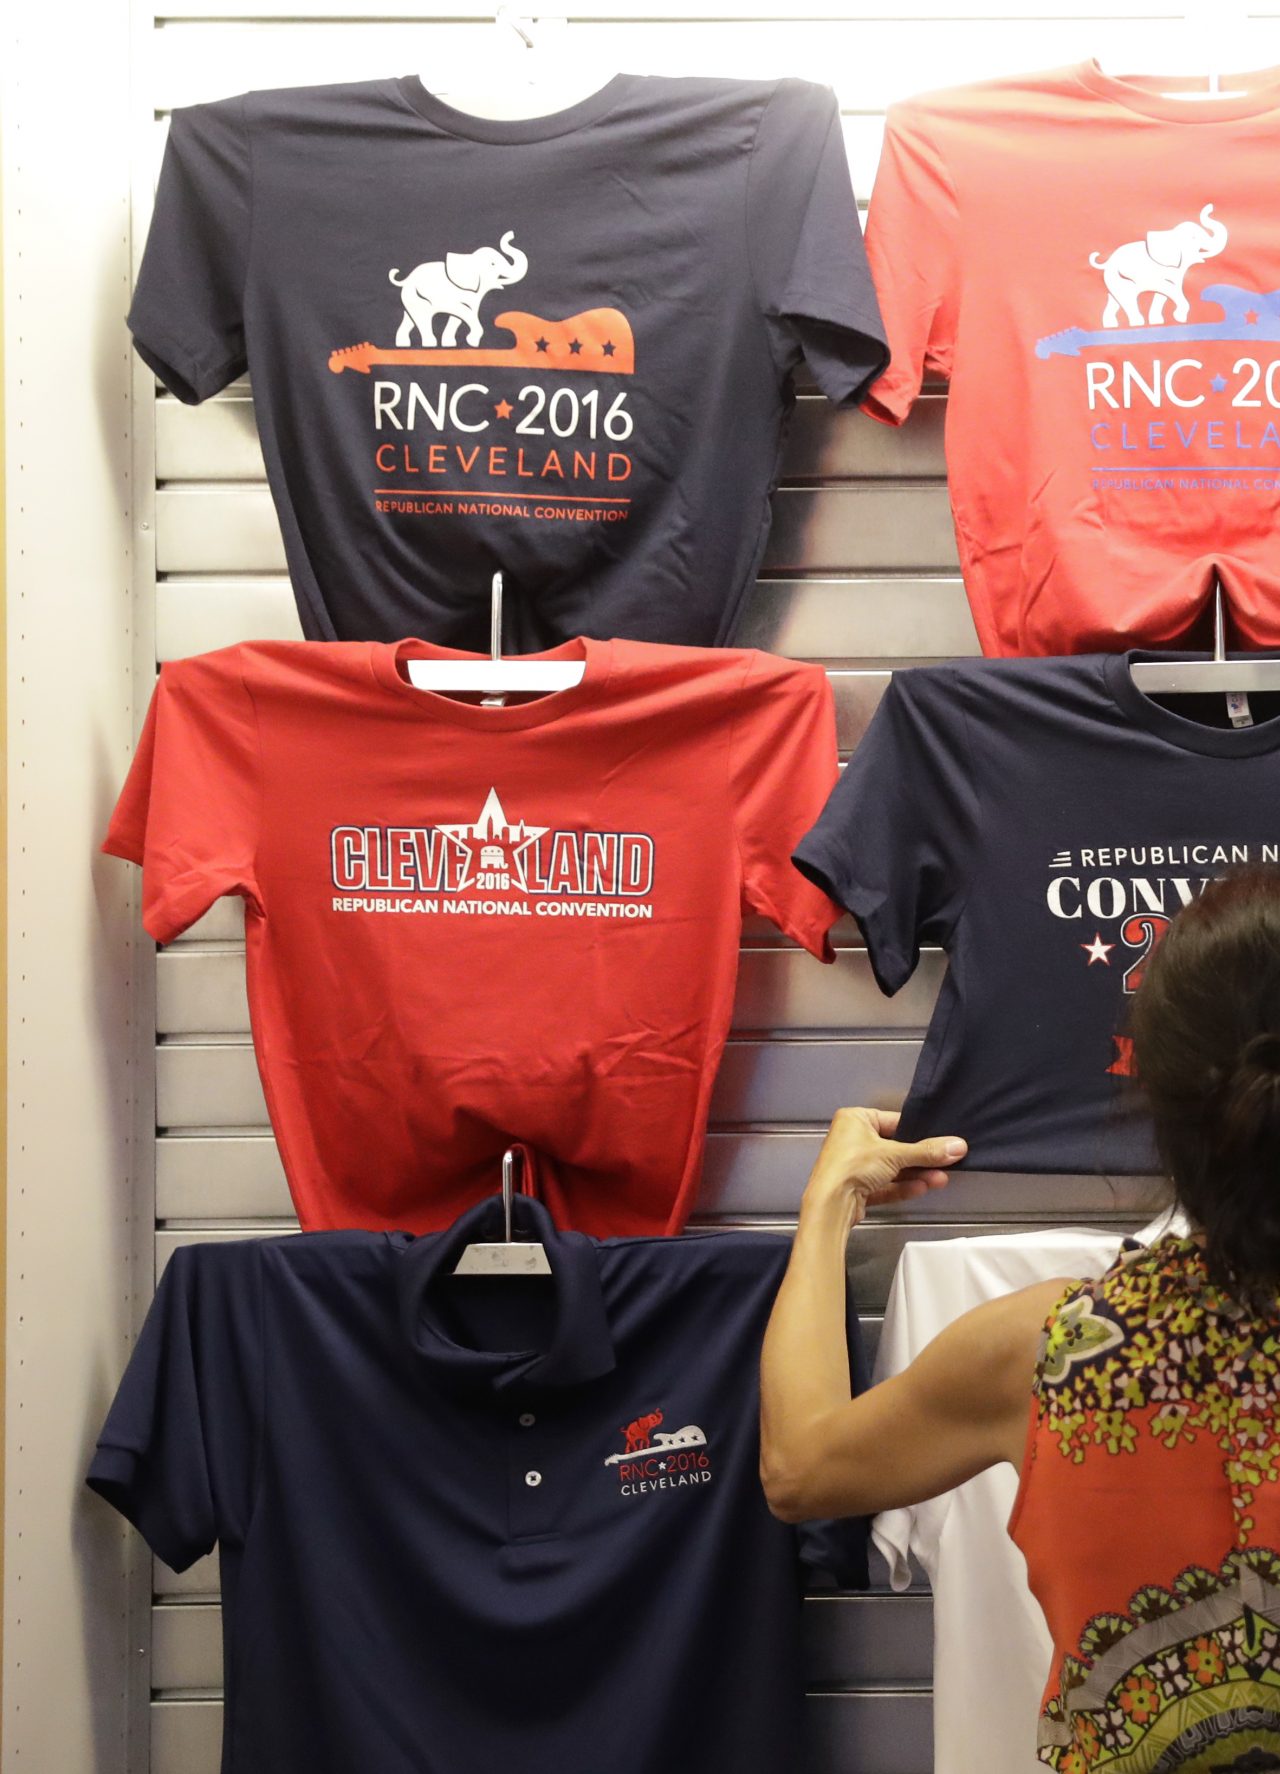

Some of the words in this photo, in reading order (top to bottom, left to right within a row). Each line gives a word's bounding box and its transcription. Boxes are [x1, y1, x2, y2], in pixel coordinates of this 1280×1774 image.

[1086, 358, 1205, 410] RNC
[374, 381, 490, 432] RNC
[515, 385, 633, 441] 2016
[375, 444, 632, 481] CLEVELAND
[1092, 478, 1174, 491] REPUBLICAN
[1178, 478, 1249, 491] NATIONAL
[375, 500, 453, 514] REPUBLICAN
[457, 503, 530, 518] NATIONAL
[534, 507, 629, 522] CONVENTION
[1081, 845, 1249, 868] REPUBLICAN
[476, 872, 510, 890] 2016
[332, 897, 439, 914] REPUBLICAN
[442, 900, 532, 916] NATIONAL
[535, 901, 653, 919] CONVENTION
[620, 1458, 659, 1482] RNC
[667, 1451, 709, 1473] 2016
[621, 1471, 712, 1496] CLEVELAND
